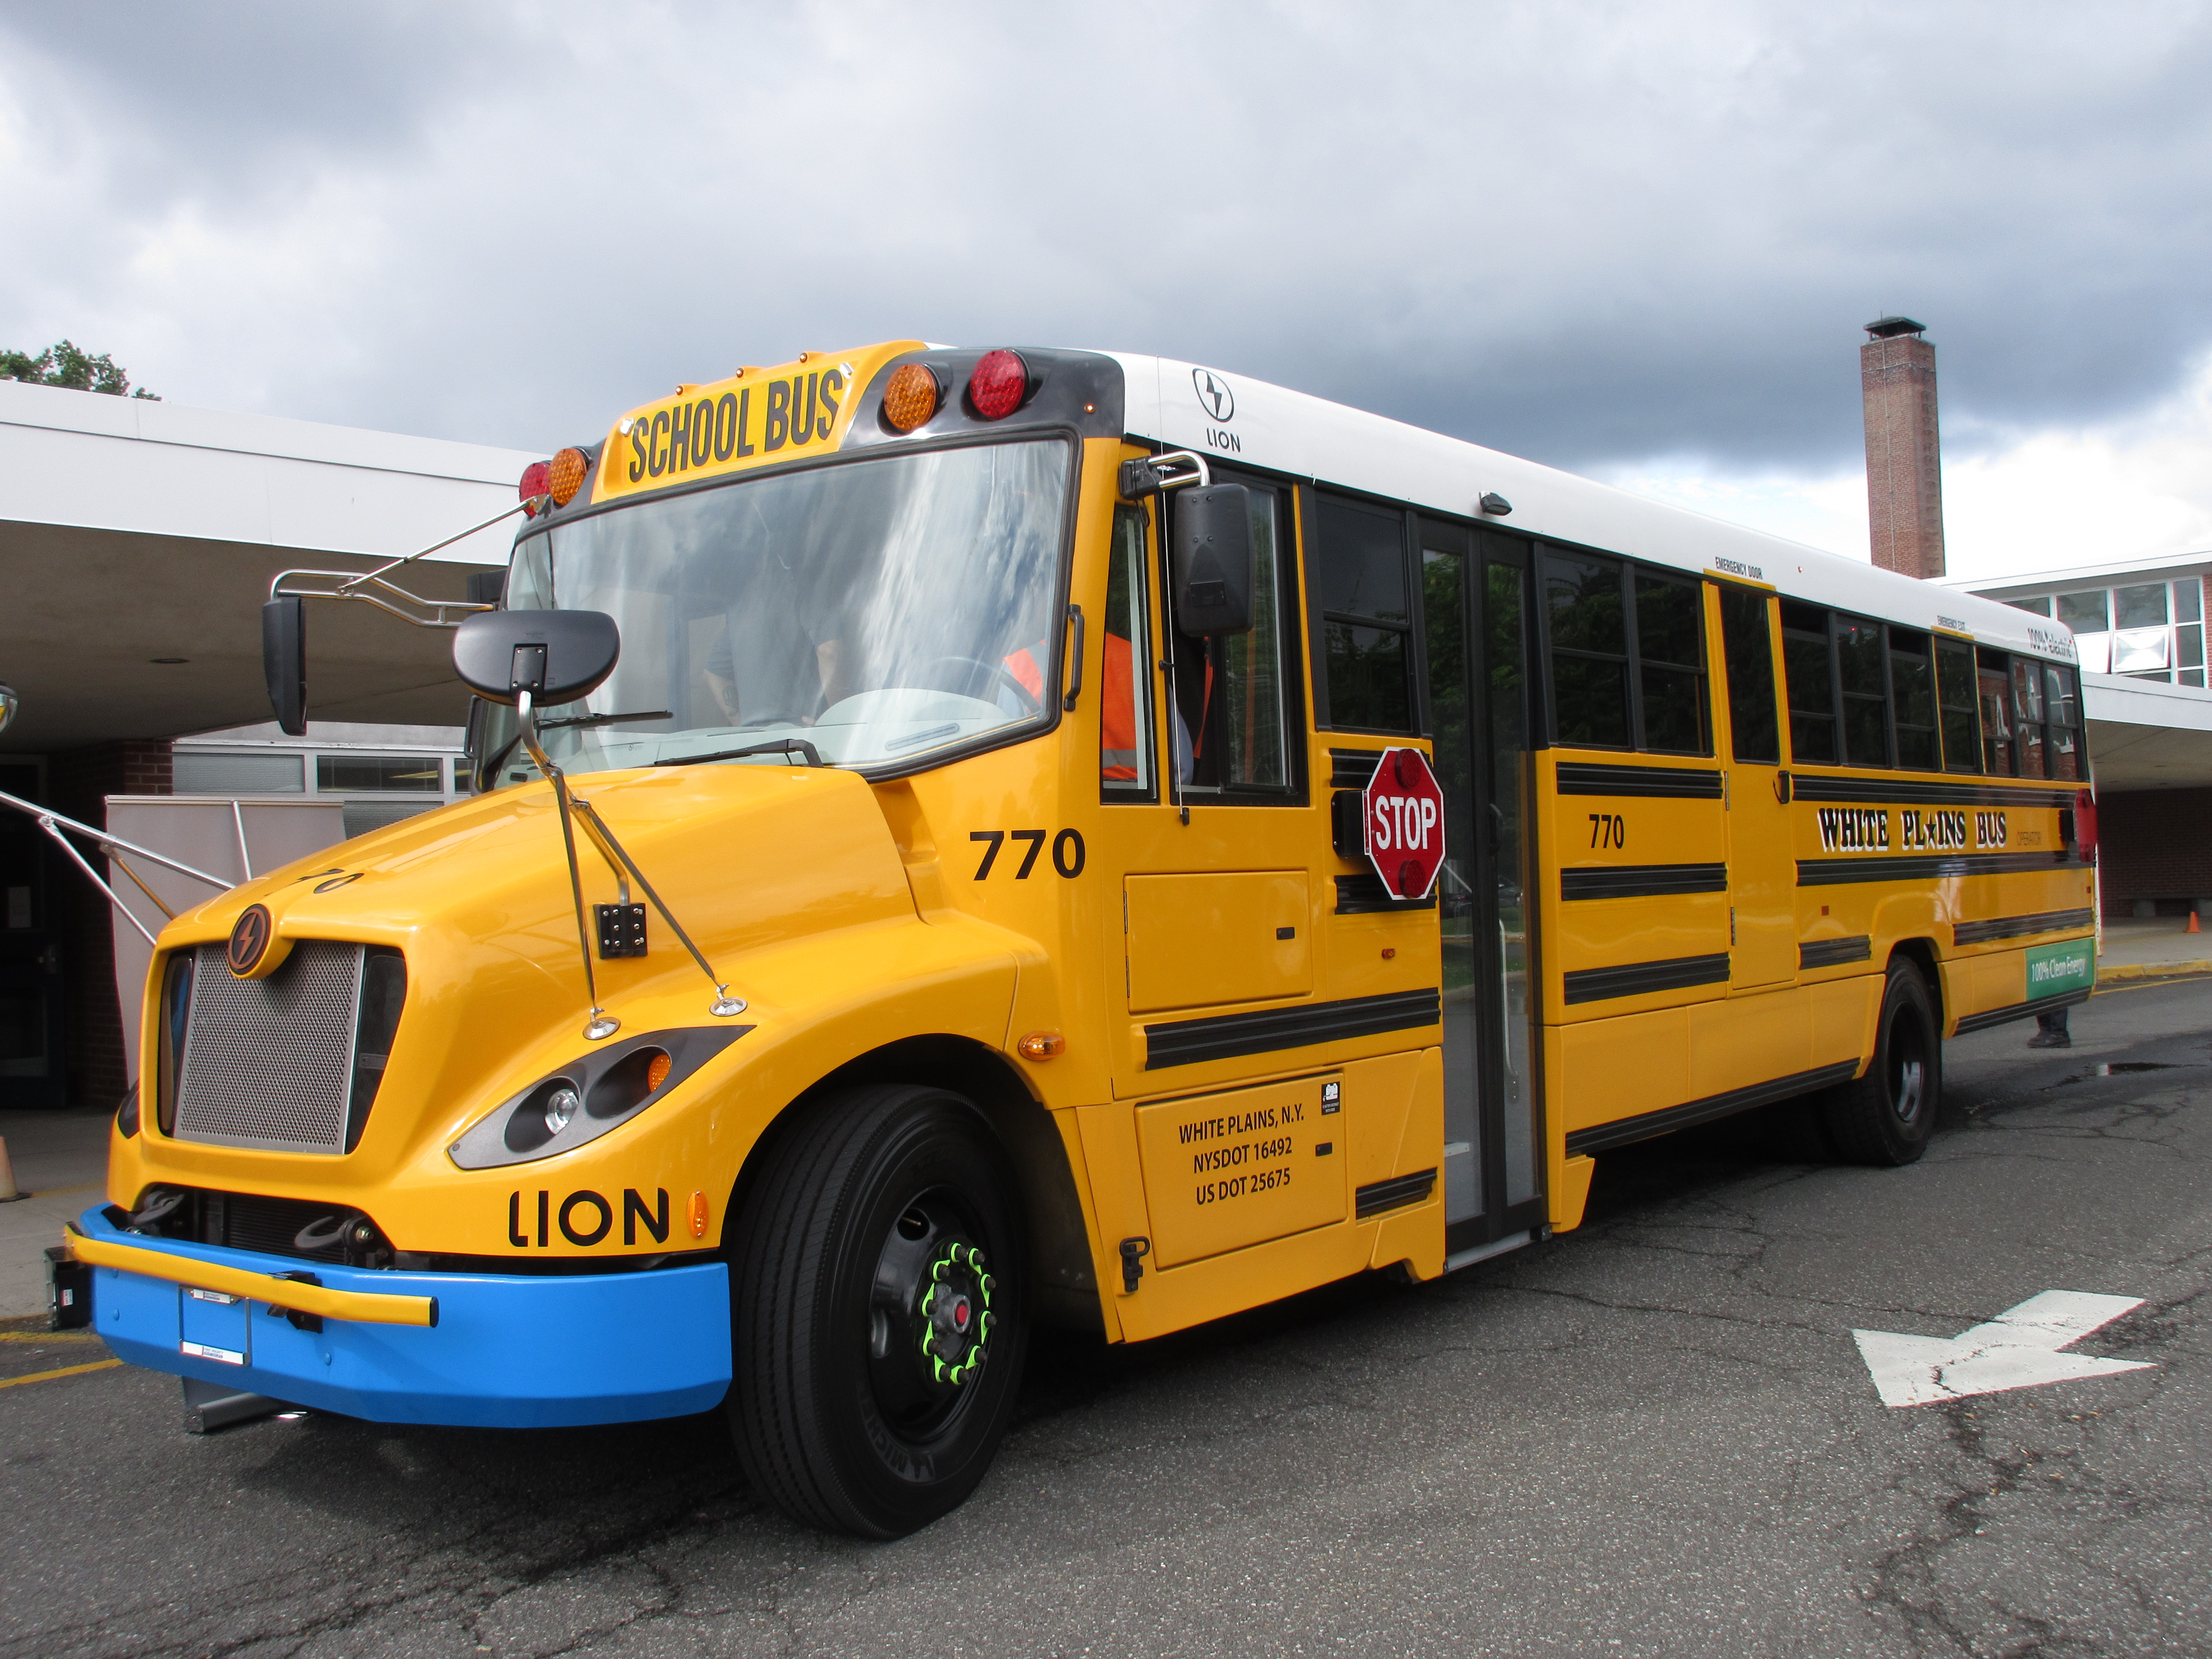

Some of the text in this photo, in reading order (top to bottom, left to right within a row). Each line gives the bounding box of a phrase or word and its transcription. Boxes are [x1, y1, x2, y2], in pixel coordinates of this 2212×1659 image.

[629, 369, 843, 483] SCHOOL BUS
[1206, 428, 1241, 452] LION
[1715, 556, 1763, 579] EMERGENCY DOOR
[1375, 795, 1437, 850] STOP
[1589, 814, 1625, 849] 770
[1817, 808, 1889, 852] WHITE
[1975, 811, 2006, 849] BUS
[969, 828, 1086, 881] 770
[1179, 1103, 1304, 1144] WHITE PLAINS, N.Y.
[1194, 1136, 1292, 1173] NYSDOT 16492
[1196, 1167, 1291, 1205] US DOT 25675
[508, 1187, 669, 1247] LION
